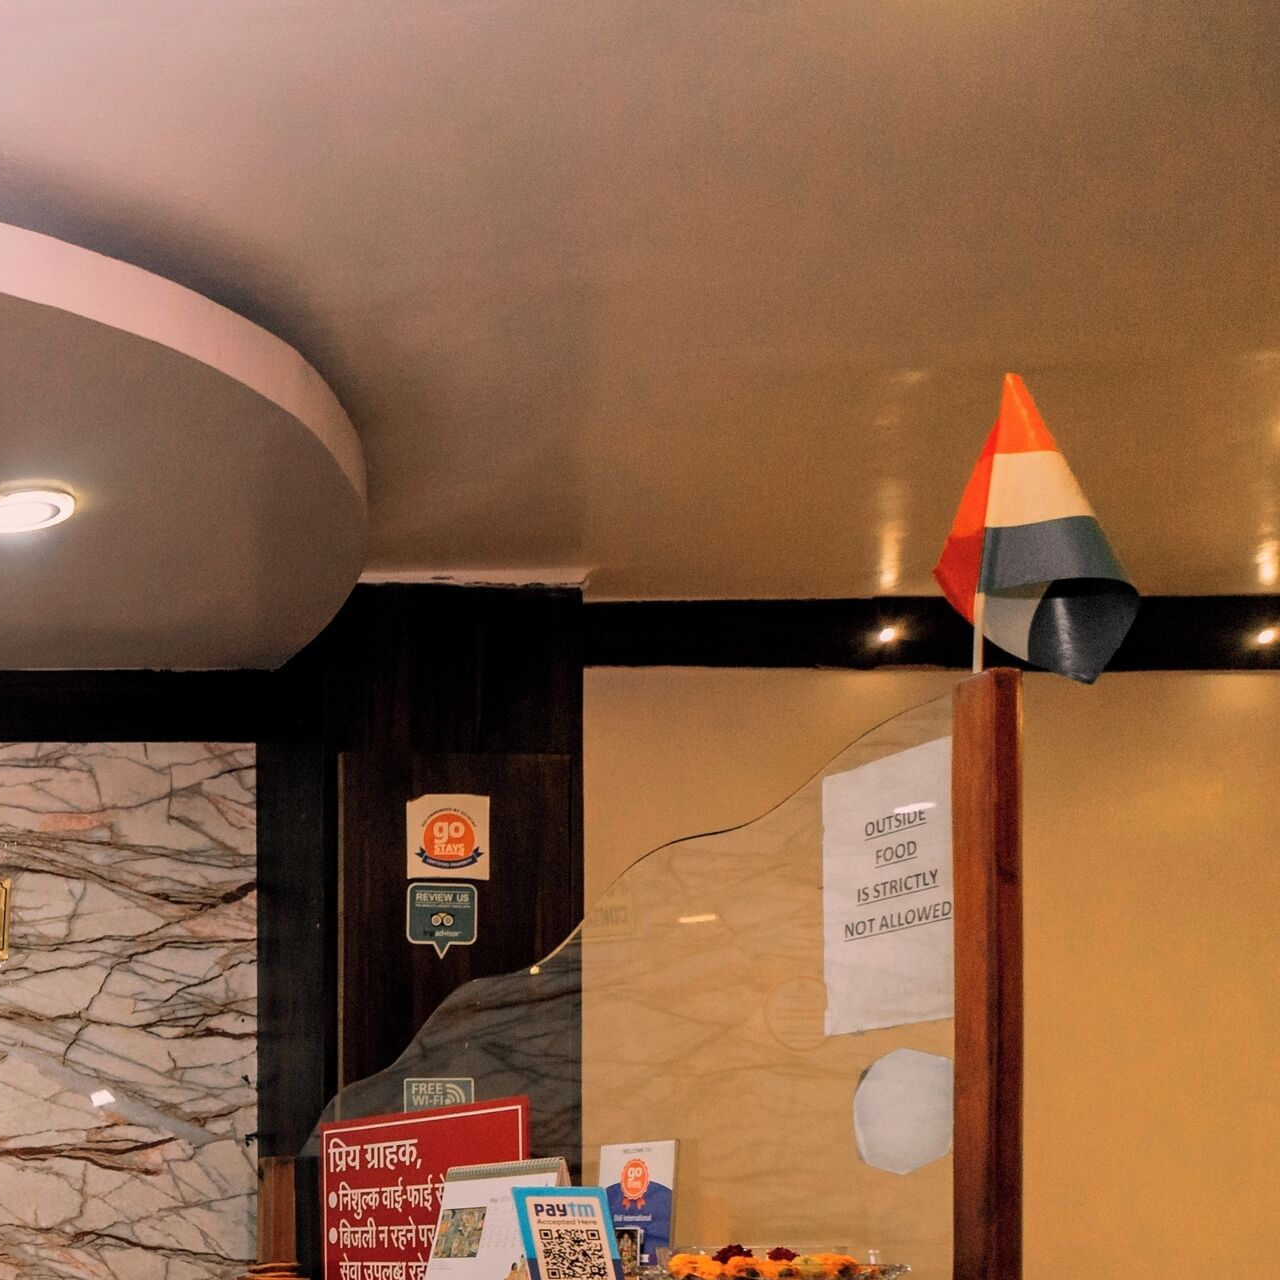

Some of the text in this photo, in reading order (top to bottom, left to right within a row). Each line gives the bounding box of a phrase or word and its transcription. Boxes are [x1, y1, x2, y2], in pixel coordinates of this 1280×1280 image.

[432, 821, 465, 844] go
[865, 808, 927, 837] OUTSIDE
[433, 844, 465, 853] STAYS
[875, 841, 917, 865] FOOD
[416, 892, 470, 902] REVIEW US
[857, 868, 938, 903] IS STRICTLY
[844, 901, 952, 939] NOT ALLOWED
[411, 1083, 444, 1095] FREE
[412, 1095, 444, 1106] WI-FI
[328, 1138, 422, 1173] प्रिय ग्राहक,
[339, 1181, 380, 1220] निशुल्क
[381, 1174, 433, 1213] वाई-फाई
[339, 1215, 436, 1251] बिजली न रहने पर
[536, 1218, 576, 1226] Accepted
